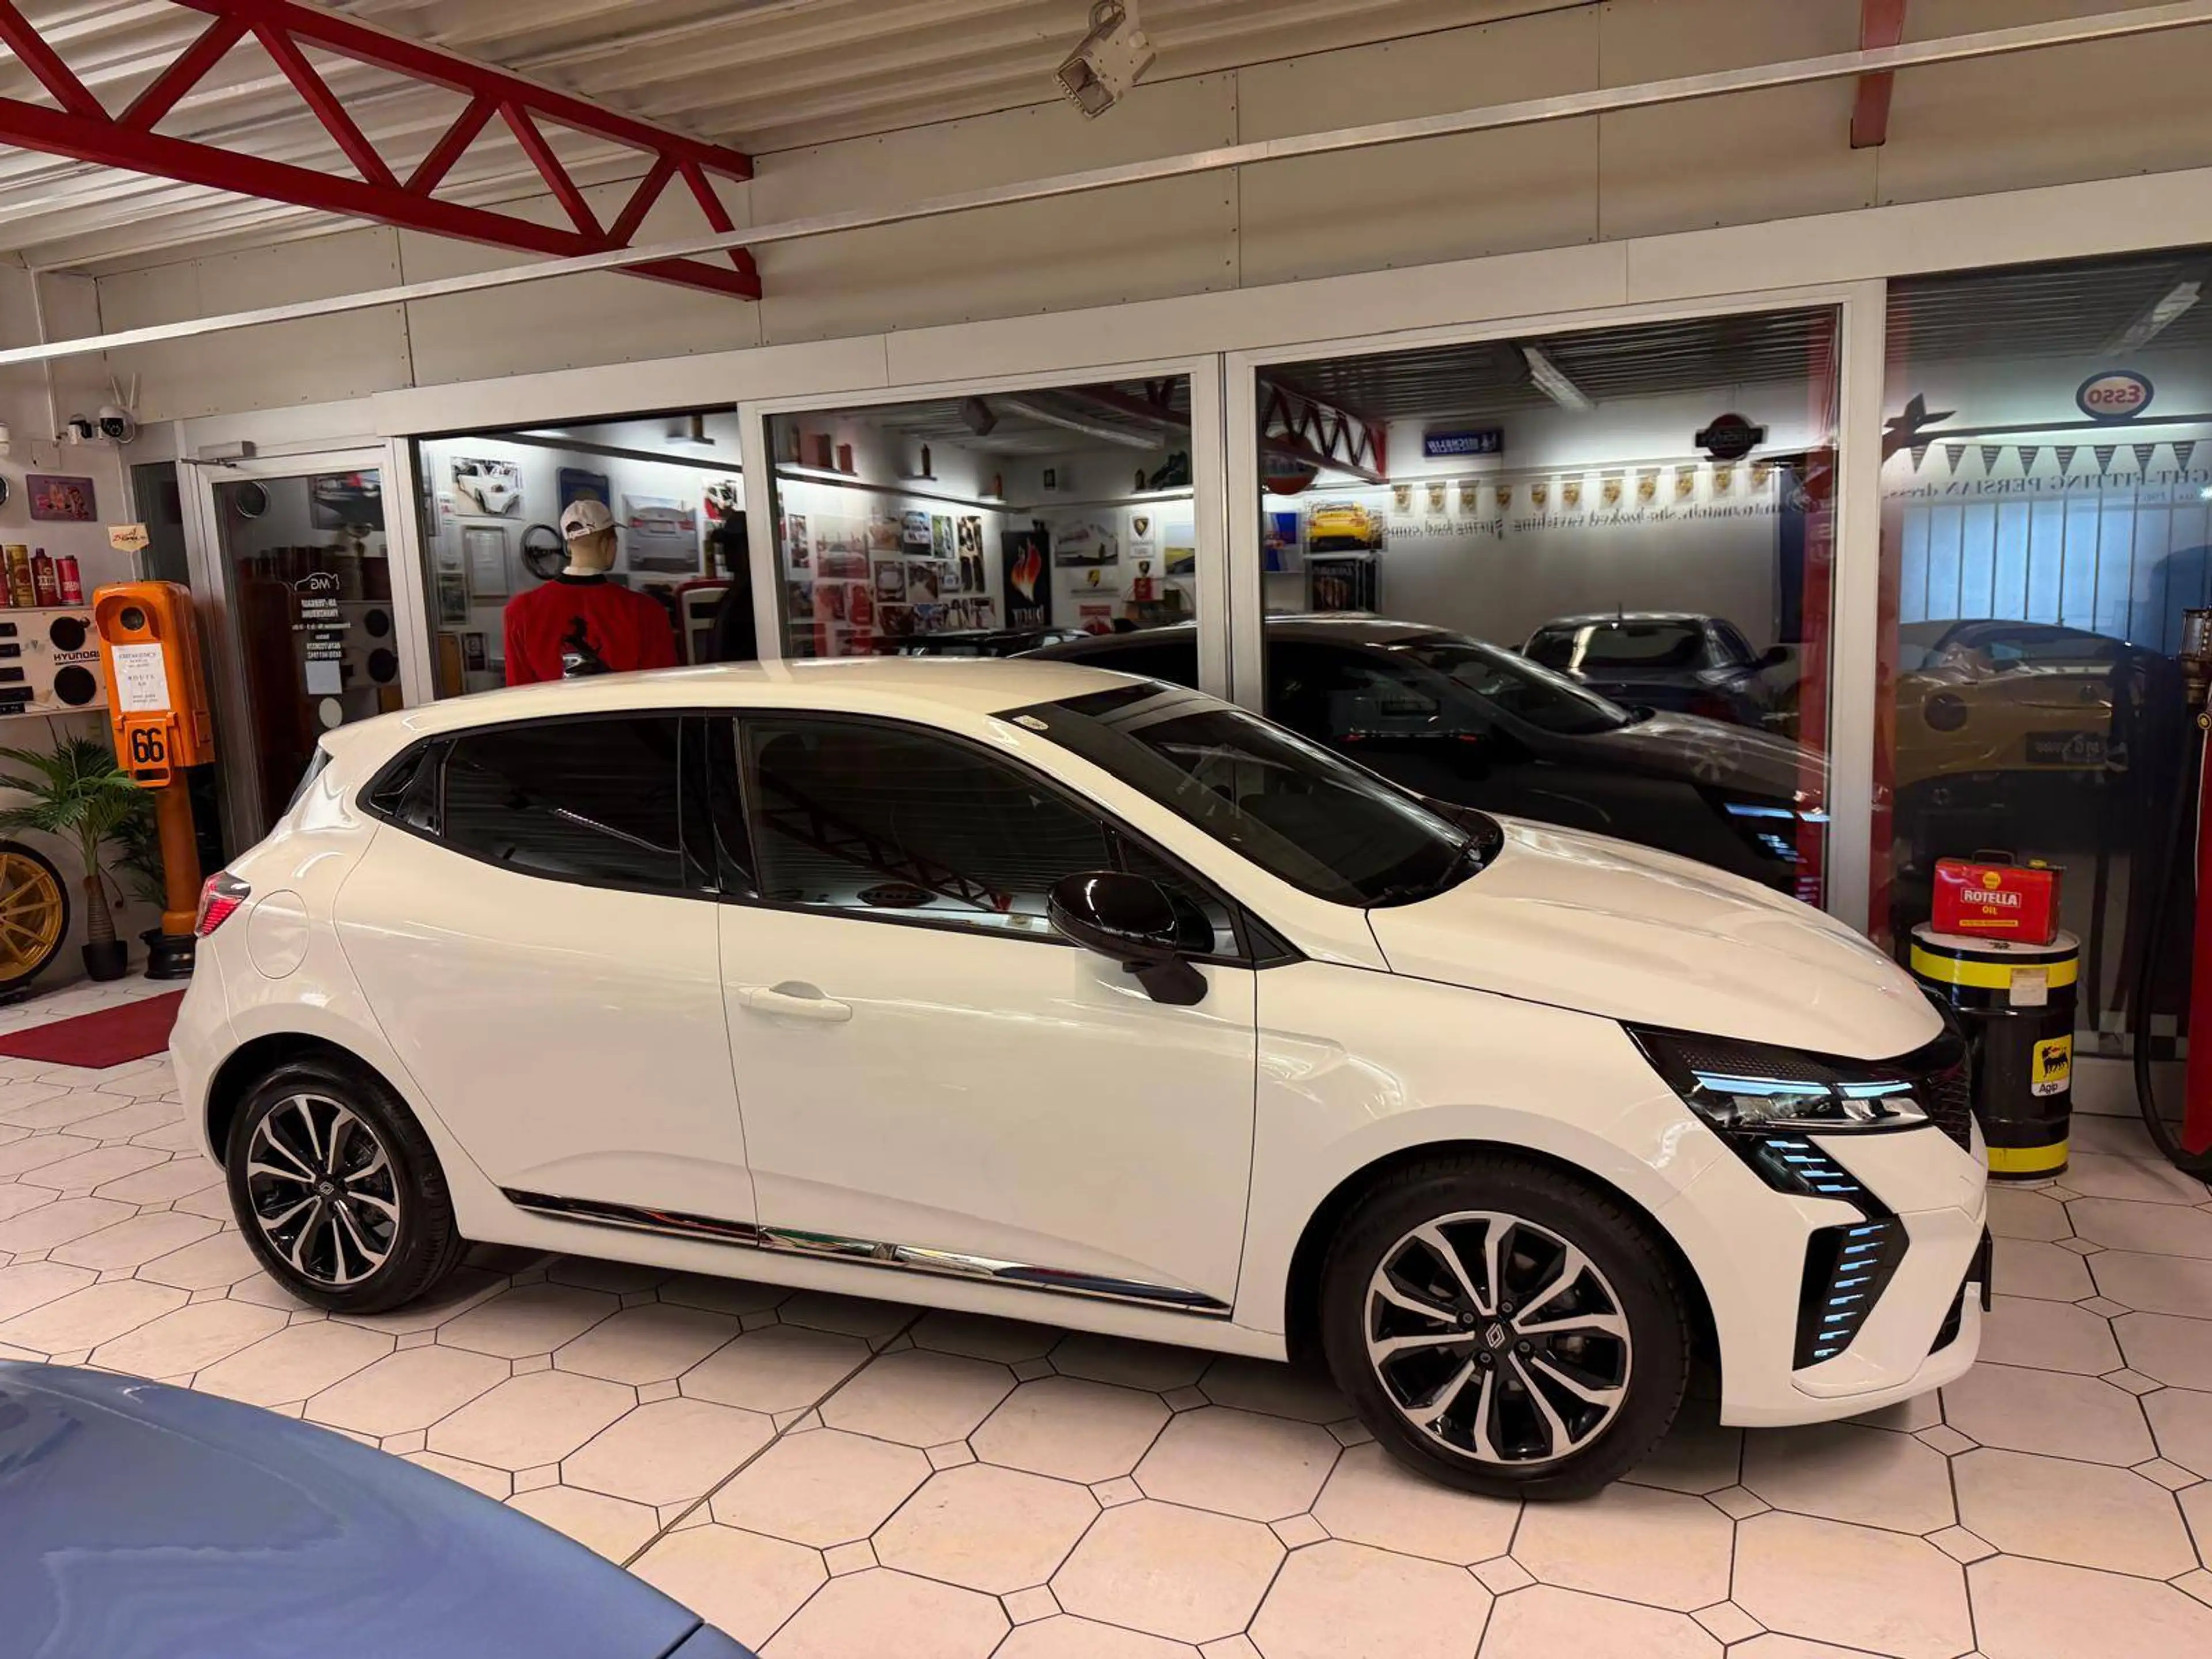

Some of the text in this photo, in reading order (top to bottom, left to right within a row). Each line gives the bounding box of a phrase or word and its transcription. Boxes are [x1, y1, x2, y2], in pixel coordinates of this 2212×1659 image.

[131, 727, 165, 763] 66
[1964, 890, 2018, 906] ROTELLA
[1982, 905, 1998, 915] OIL
